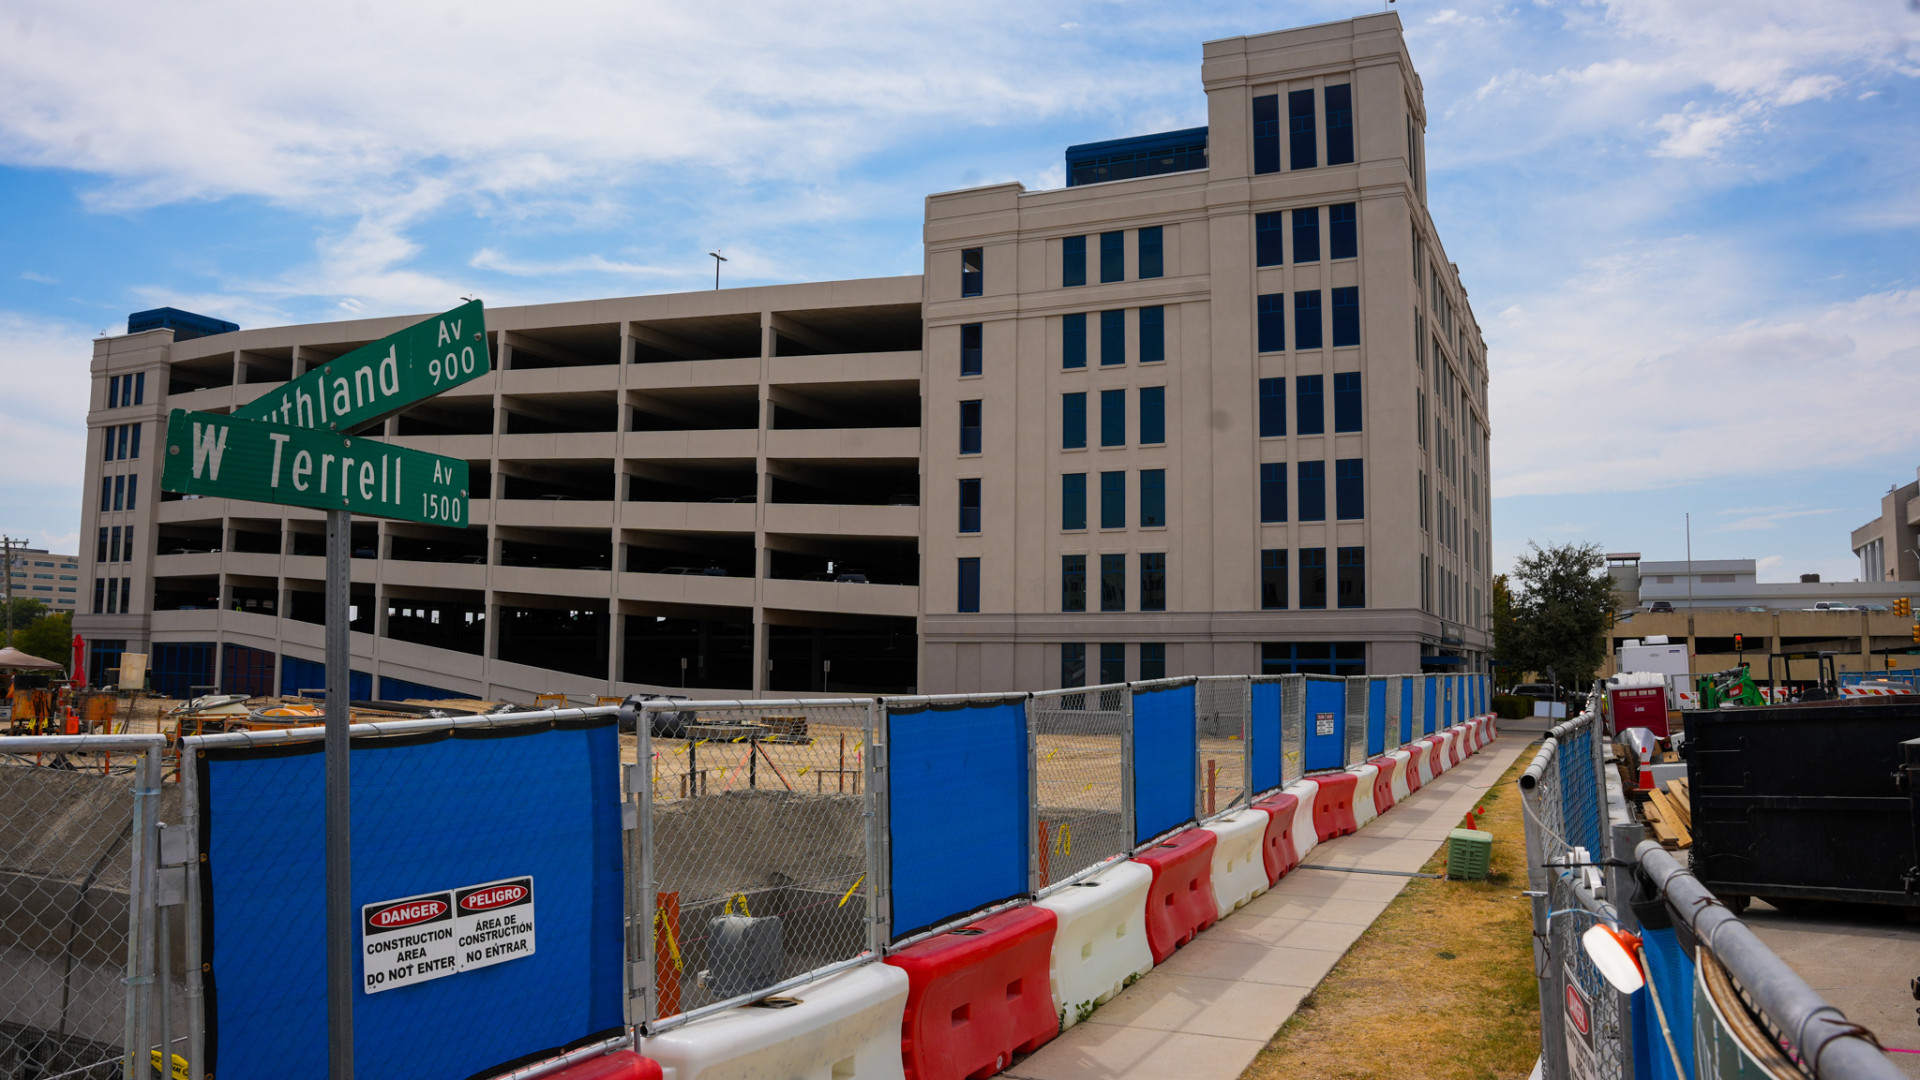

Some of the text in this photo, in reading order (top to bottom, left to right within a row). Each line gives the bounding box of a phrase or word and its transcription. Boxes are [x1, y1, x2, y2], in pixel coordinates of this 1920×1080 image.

[437, 319, 462, 347] Av
[428, 346, 475, 386] 900
[192, 422, 453, 505] W Terrell Av
[423, 493, 461, 523] 1500
[469, 888, 521, 907] PELIGRO
[381, 903, 438, 924] DANGER
[475, 914, 517, 933] ÁREA DE
[367, 928, 452, 954] CONSTRUCTION
[466, 939, 527, 963] NO ENTRAR
[396, 947, 427, 963] AREA
[367, 955, 456, 986] DO NOT ENTER
